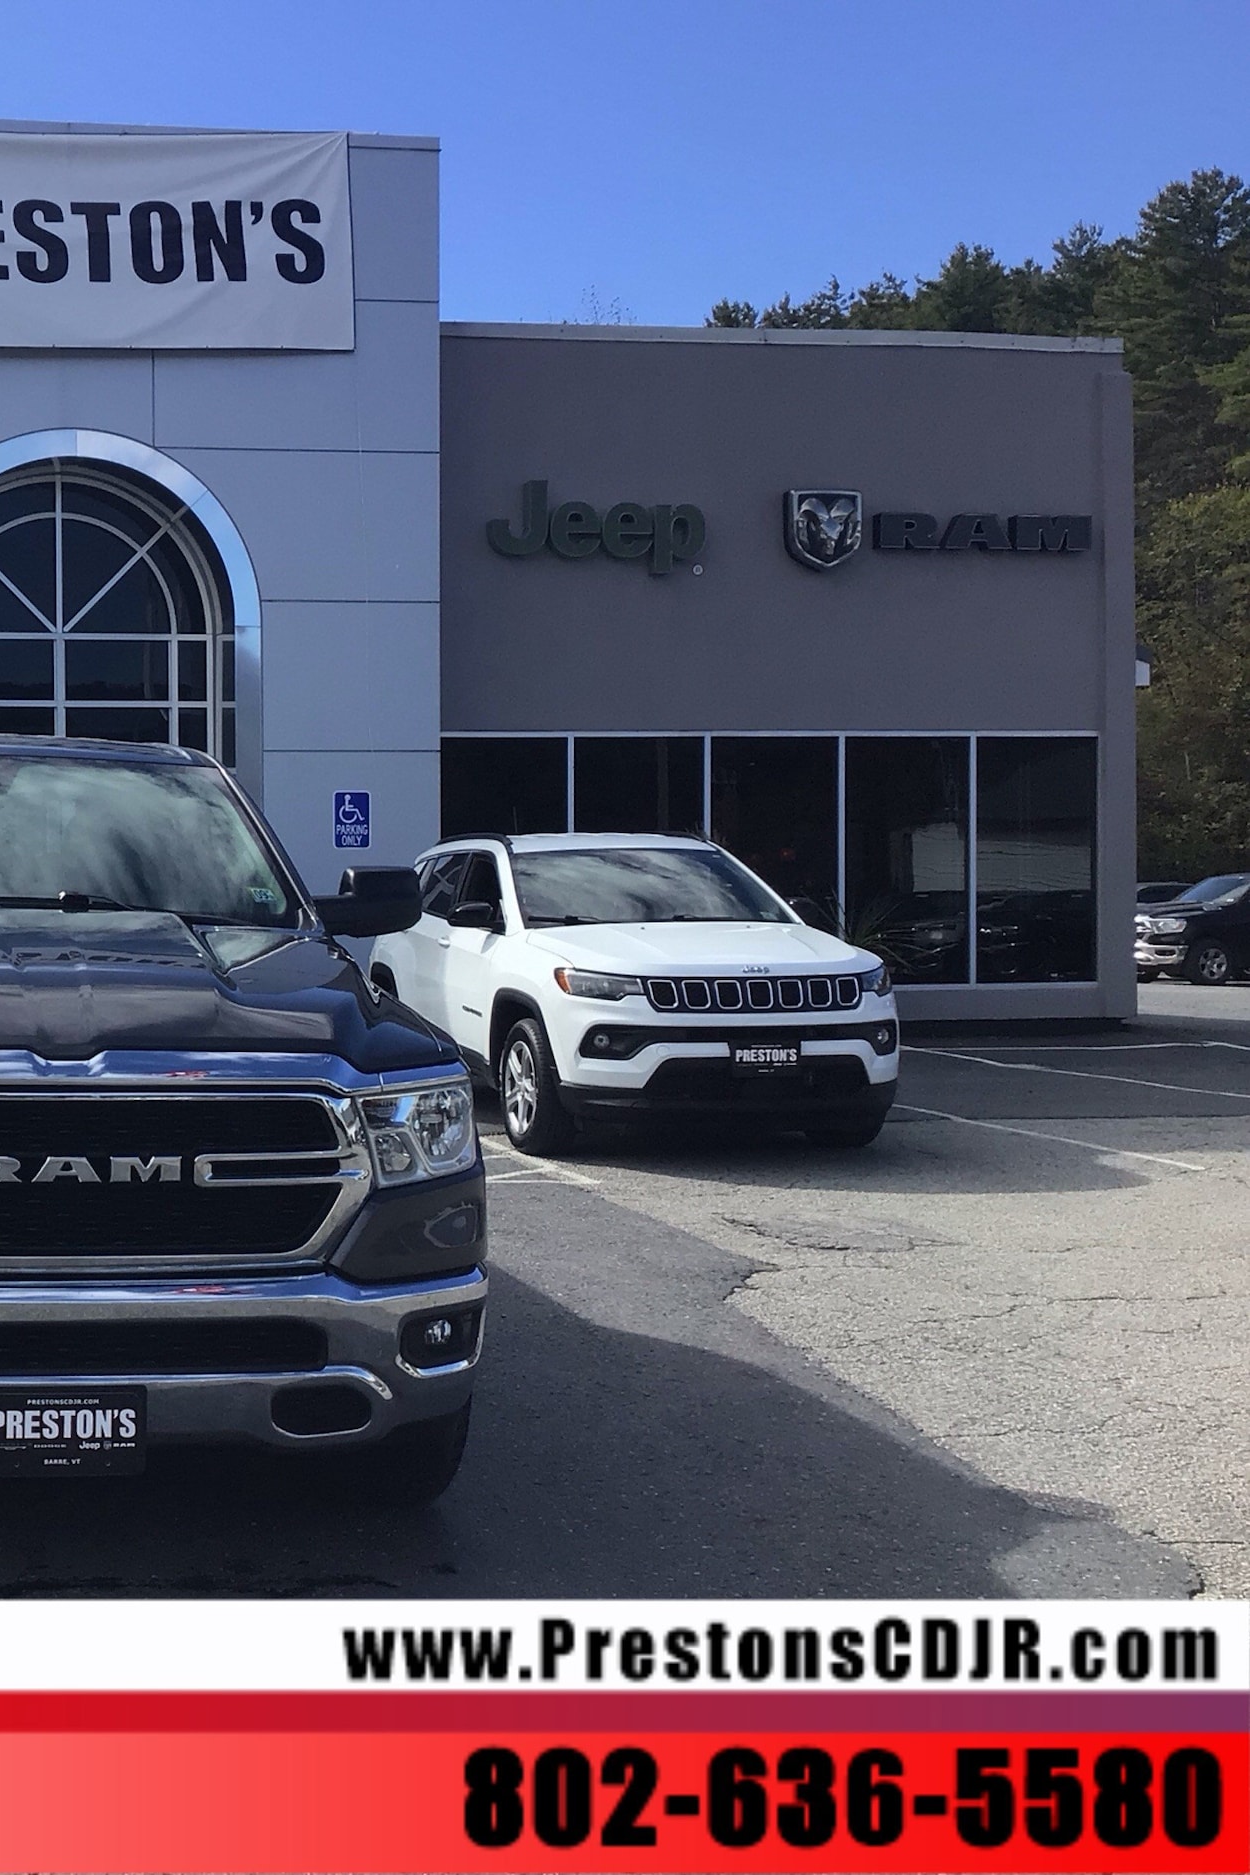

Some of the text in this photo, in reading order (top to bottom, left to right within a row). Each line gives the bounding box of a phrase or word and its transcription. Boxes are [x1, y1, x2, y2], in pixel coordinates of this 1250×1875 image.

[485, 480, 706, 574] Jeep
[872, 511, 1092, 552] RAM
[336, 824, 368, 835] PARKING
[341, 835, 362, 846] ONLY
[742, 964, 770, 974] Jeep
[735, 1048, 798, 1062] PRESTON'S
[79, 1441, 100, 1450] Jeep
